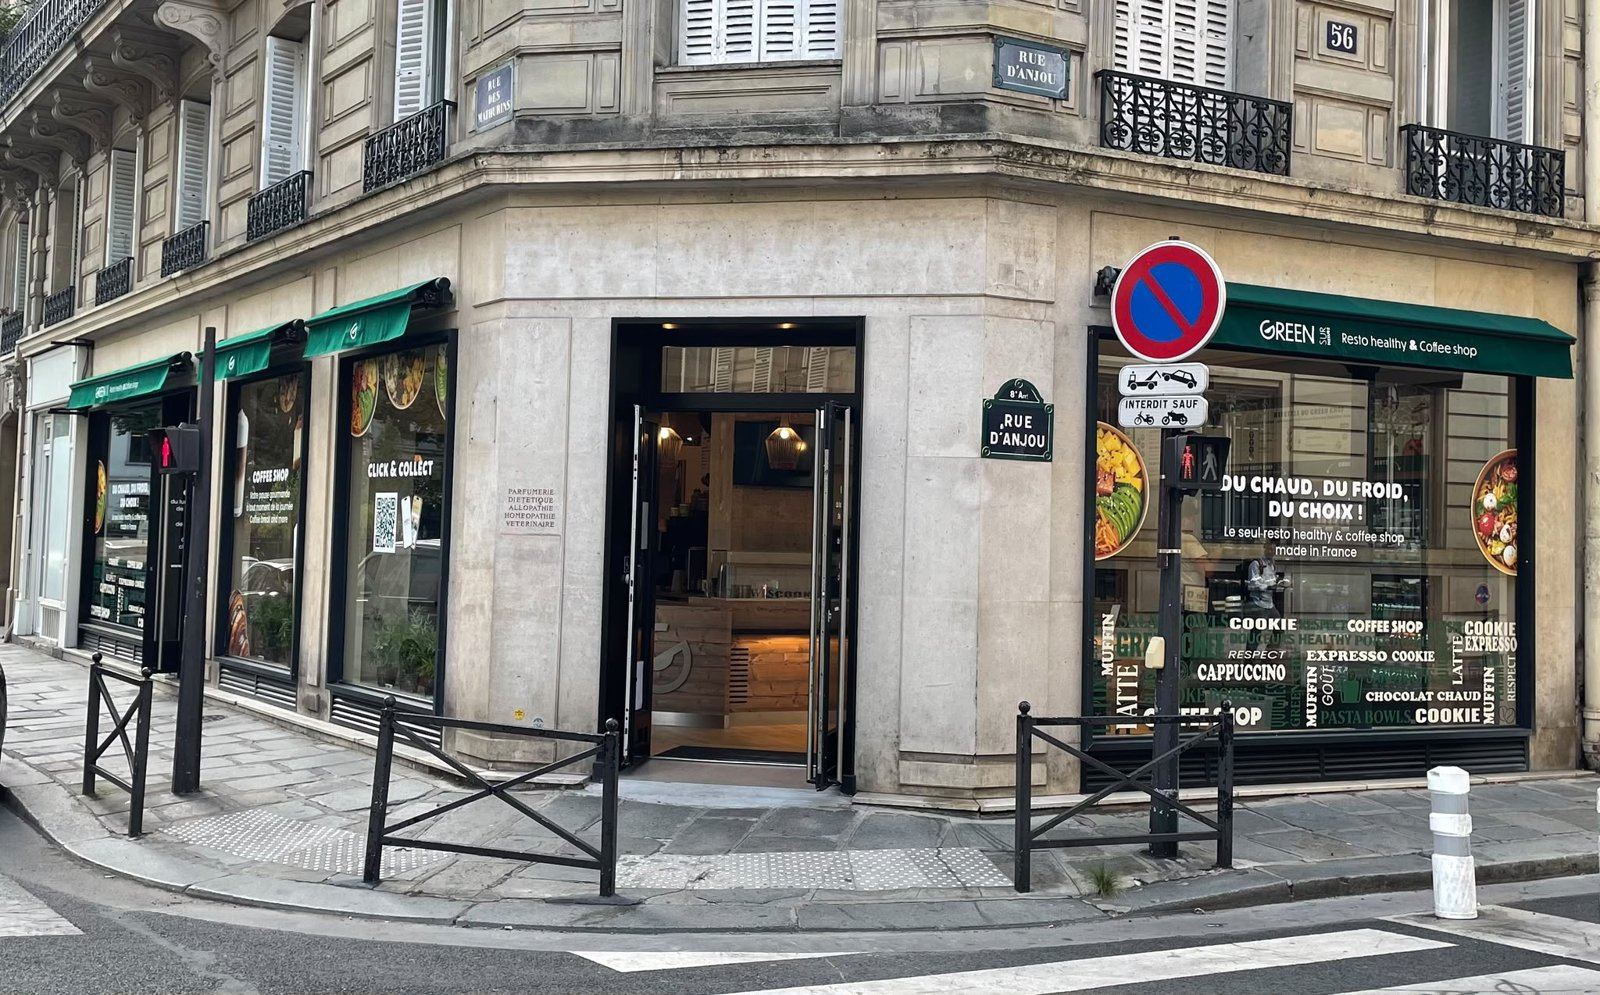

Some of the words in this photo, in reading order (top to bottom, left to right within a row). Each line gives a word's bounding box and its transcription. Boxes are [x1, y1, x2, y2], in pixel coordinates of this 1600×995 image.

[1330, 25, 1354, 48] 56
[1018, 50, 1046, 66] RUE
[1007, 64, 1057, 86] D'ANJOU
[488, 76, 501, 92] RUE
[1260, 320, 1315, 344] GREEN
[1319, 326, 1327, 346] SUR
[1342, 332, 1368, 346] Resto
[1370, 336, 1407, 352] healthy
[1409, 340, 1418, 350] &
[1420, 340, 1451, 354] Coffee
[1452, 343, 1478, 358] shop
[1125, 399, 1167, 410] INTERDIT
[1172, 399, 1199, 410] SAUF
[1004, 414, 1032, 429] RUE
[990, 431, 1045, 448] D'ANJOU
[252, 470, 273, 484] COFFEE
[273, 468, 289, 482] SHOP
[368, 462, 388, 478] CLICK
[390, 462, 397, 476] &
[398, 460, 434, 476] COLLECT
[1222, 474, 1246, 493] DU
[1250, 475, 1318, 499] CHAUD,
[1323, 479, 1348, 498] DU
[1352, 480, 1409, 502] FROID,
[508, 497, 554, 505] DIETETIQUE
[1268, 501, 1294, 519] DU
[1298, 501, 1353, 521] CHOIX
[1358, 503, 1364, 520] !
[1224, 526, 1235, 537] Le
[1238, 526, 1260, 538] seul
[1263, 528, 1291, 540] resto
[1293, 528, 1333, 544] healthy
[1336, 530, 1343, 542] &
[1346, 530, 1379, 543] coffee
[1382, 532, 1404, 546] shop
[1276, 545, 1306, 556] made
[1309, 545, 1320, 556] in
[1322, 546, 1357, 558] France
[1230, 617, 1298, 630] COOKIE
[1347, 619, 1390, 632] COFFEE
[1392, 620, 1423, 633] SHOP
[1464, 621, 1516, 636] COOKIE
[1101, 613, 1116, 676] MUFFIN
[1465, 636, 1518, 652] EXPRESSO
[1228, 650, 1287, 659] RESPECT
[1307, 650, 1388, 662] EXPRESSO
[1392, 651, 1436, 662] COOKIE
[1452, 636, 1463, 685] LATTE
[1197, 663, 1286, 681] CAPPUCCINO
[1507, 655, 1516, 702] RESPECT
[1306, 666, 1318, 728] MUFFIN
[1365, 692, 1434, 701] CHOCOLAT
[1437, 692, 1481, 701] CHAUD
[1483, 667, 1495, 724] MUFFIN
[1321, 710, 1362, 725] PASTA
[1365, 710, 1410, 724] BOWLS
[1415, 708, 1480, 724] COOKIE
